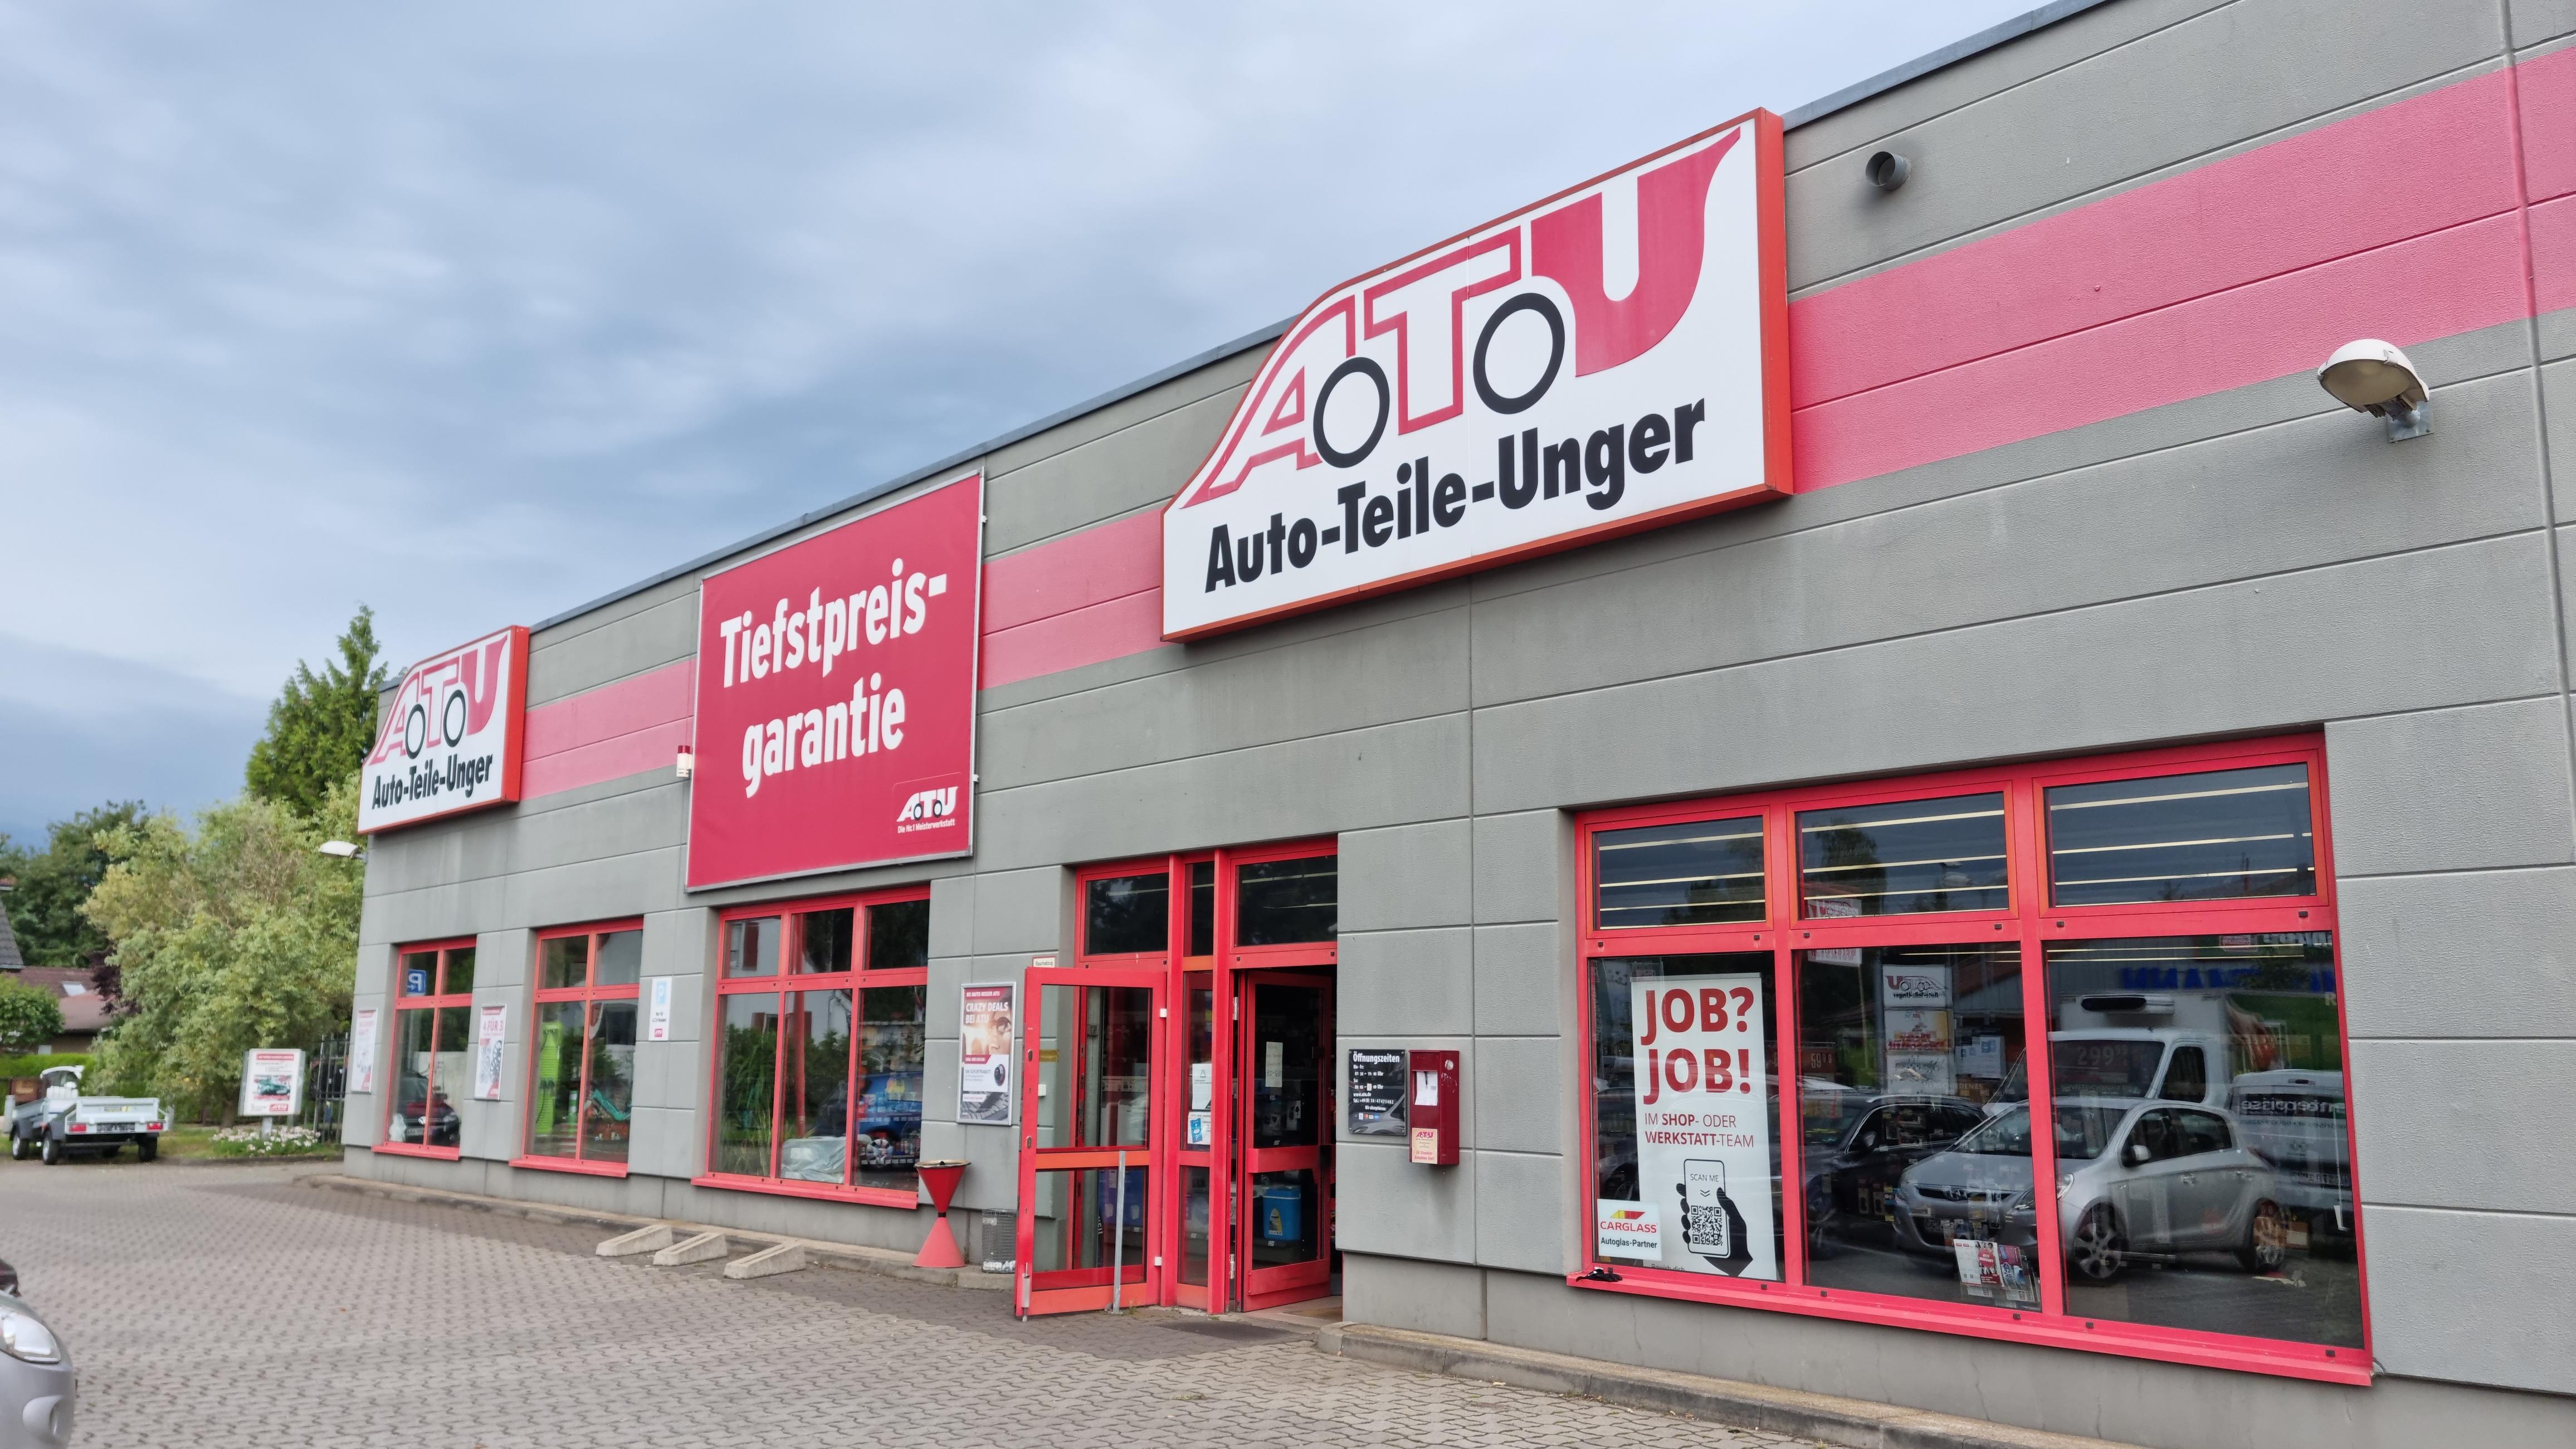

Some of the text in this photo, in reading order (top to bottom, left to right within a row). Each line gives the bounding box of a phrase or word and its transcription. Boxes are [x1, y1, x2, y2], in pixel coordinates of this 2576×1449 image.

[1181, 126, 1740, 508] ATU
[1204, 397, 1705, 593] Auto-Teile-Unger
[720, 558, 947, 688] Tiefstpreis-
[369, 634, 508, 765] ATU
[742, 672, 905, 798] garantie
[372, 754, 494, 810] Auto-Teile-Unger
[896, 786, 958, 822] ATU
[897, 825, 906, 833] Die
[915, 818, 955, 831] Meisterwerkstatt
[965, 1002, 1009, 1012] CRAZY DEALS
[965, 1014, 990, 1024] BEI ATU
[1641, 987, 1754, 1046] JOB?
[1353, 1051, 1400, 1065] Öffnungszeiten
[1643, 1048, 1751, 1105] JOB!
[1645, 1113, 1736, 1128] IM SHOP- ODER
[1645, 1131, 1754, 1148] WERKSTATT-TEAM
[1600, 1221, 1657, 1233] CARGLASS
[1601, 1237, 1657, 1248] Autoglas-Partner
